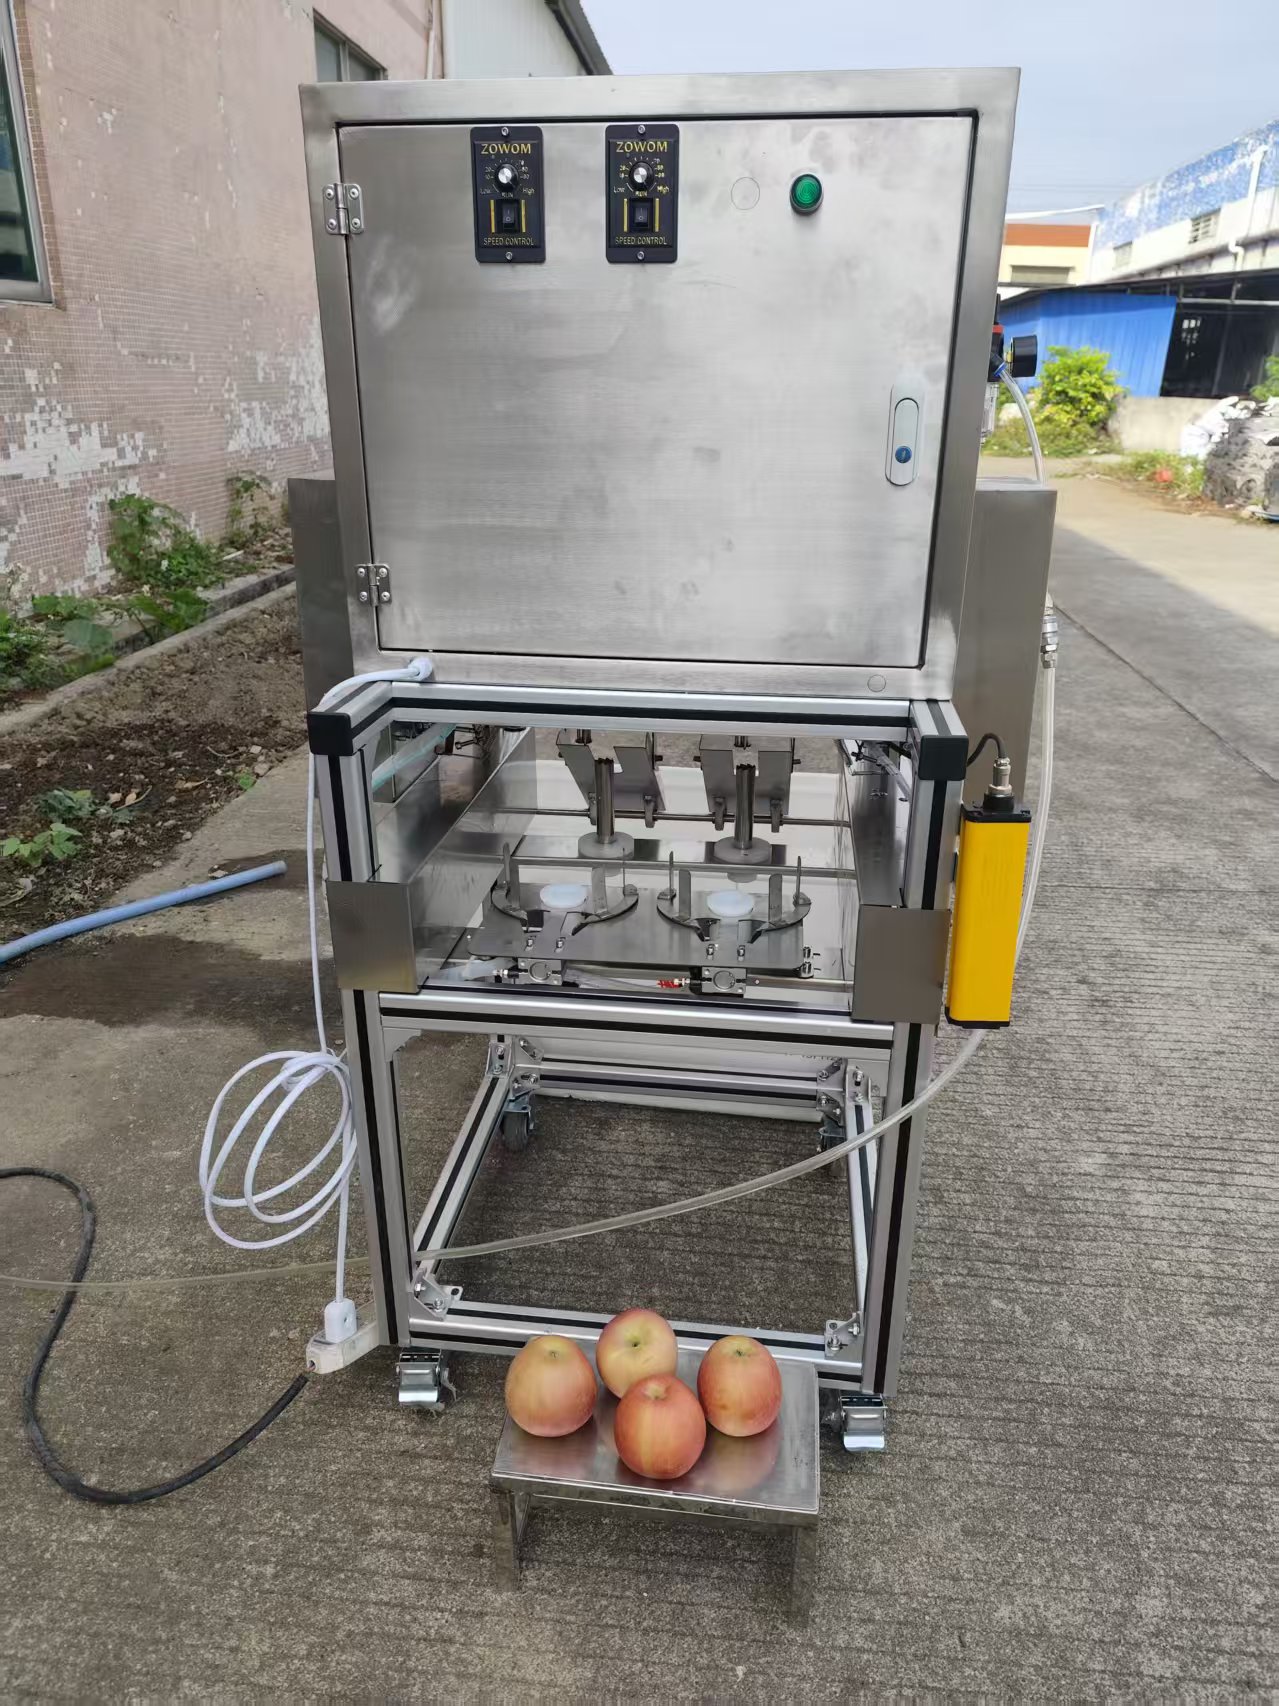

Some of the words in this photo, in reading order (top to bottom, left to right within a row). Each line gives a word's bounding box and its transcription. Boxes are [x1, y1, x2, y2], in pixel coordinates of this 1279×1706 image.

[481, 143, 531, 154] ZOWOM
[616, 141, 668, 153] ZOWOM
[522, 187, 535, 196] High
[613, 185, 625, 193] Low
[657, 185, 670, 195] High
[483, 237, 504, 246] SPEED
[505, 237, 534, 246] CONTROL
[615, 236, 636, 245] SPEED
[637, 236, 667, 245] CONTROL
